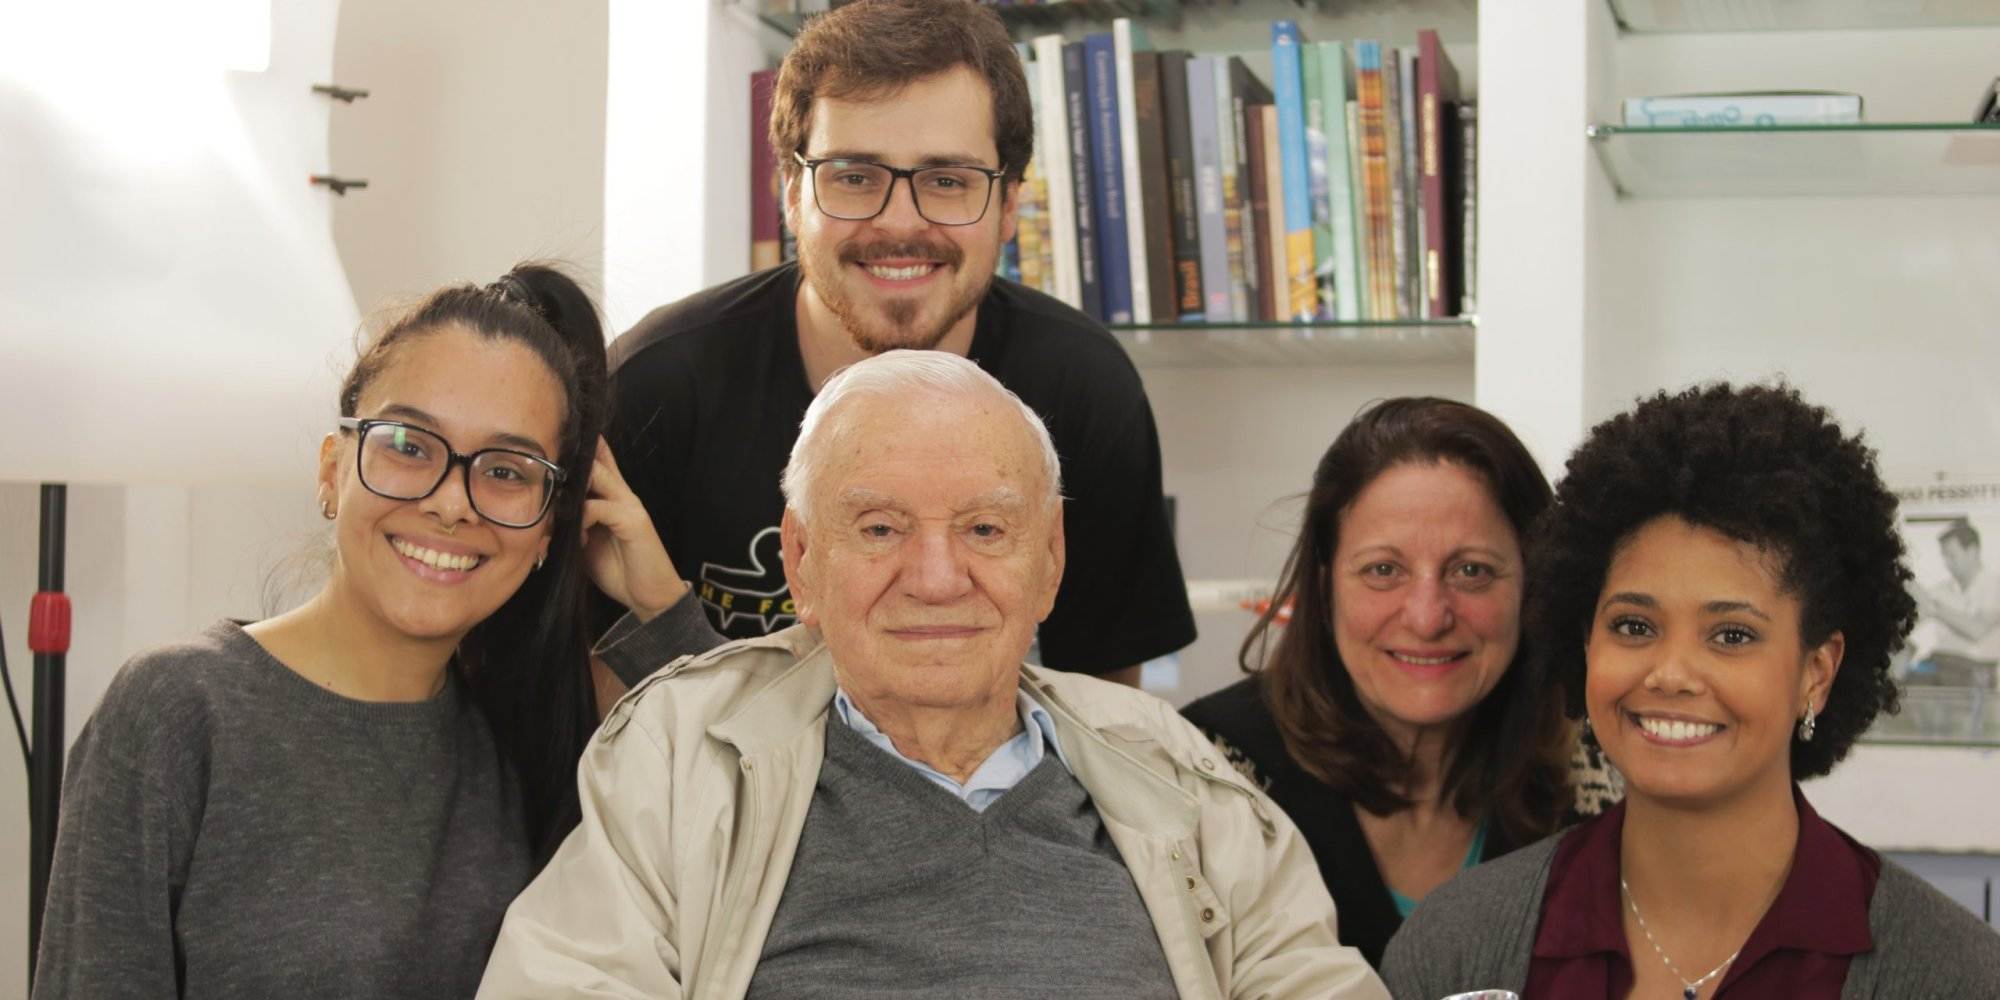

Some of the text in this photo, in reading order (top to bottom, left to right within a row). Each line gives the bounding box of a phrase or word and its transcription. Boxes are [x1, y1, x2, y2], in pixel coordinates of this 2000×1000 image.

[1179, 260, 1199, 309] Brasil
[702, 583, 796, 613] HE FO
